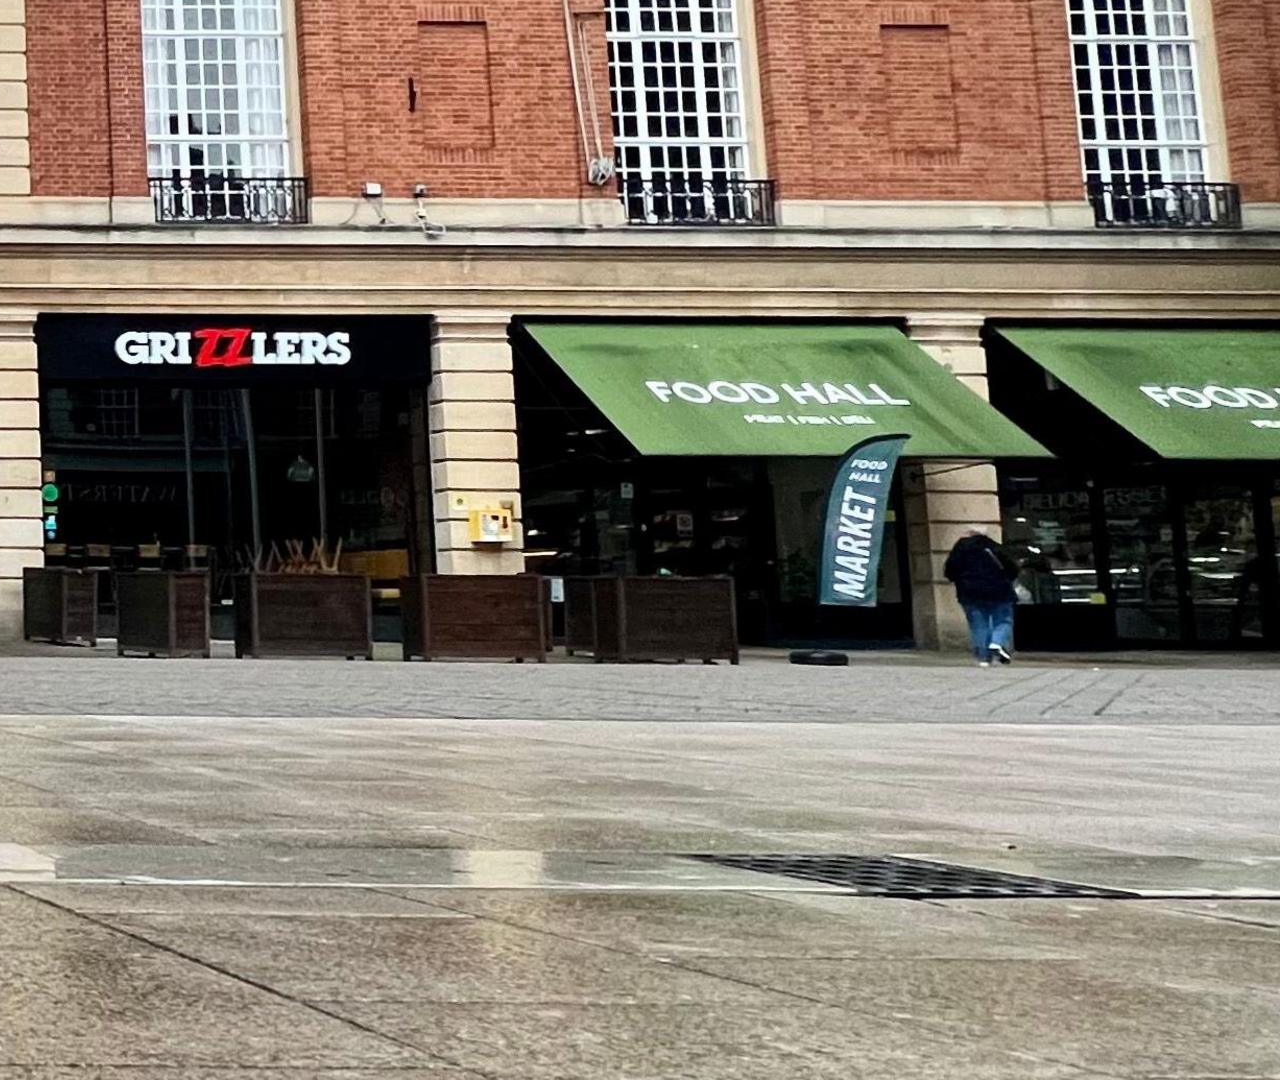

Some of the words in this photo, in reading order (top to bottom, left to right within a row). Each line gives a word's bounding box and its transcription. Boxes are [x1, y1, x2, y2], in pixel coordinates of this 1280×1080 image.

[114, 327, 352, 368] GRIZZLERS
[645, 380, 780, 404] FOOD
[781, 382, 911, 406] HALL
[1139, 385, 1278, 409] FOOD
[850, 459, 888, 470] FOOD
[848, 471, 881, 484] HALL
[832, 485, 877, 599] MARKET
